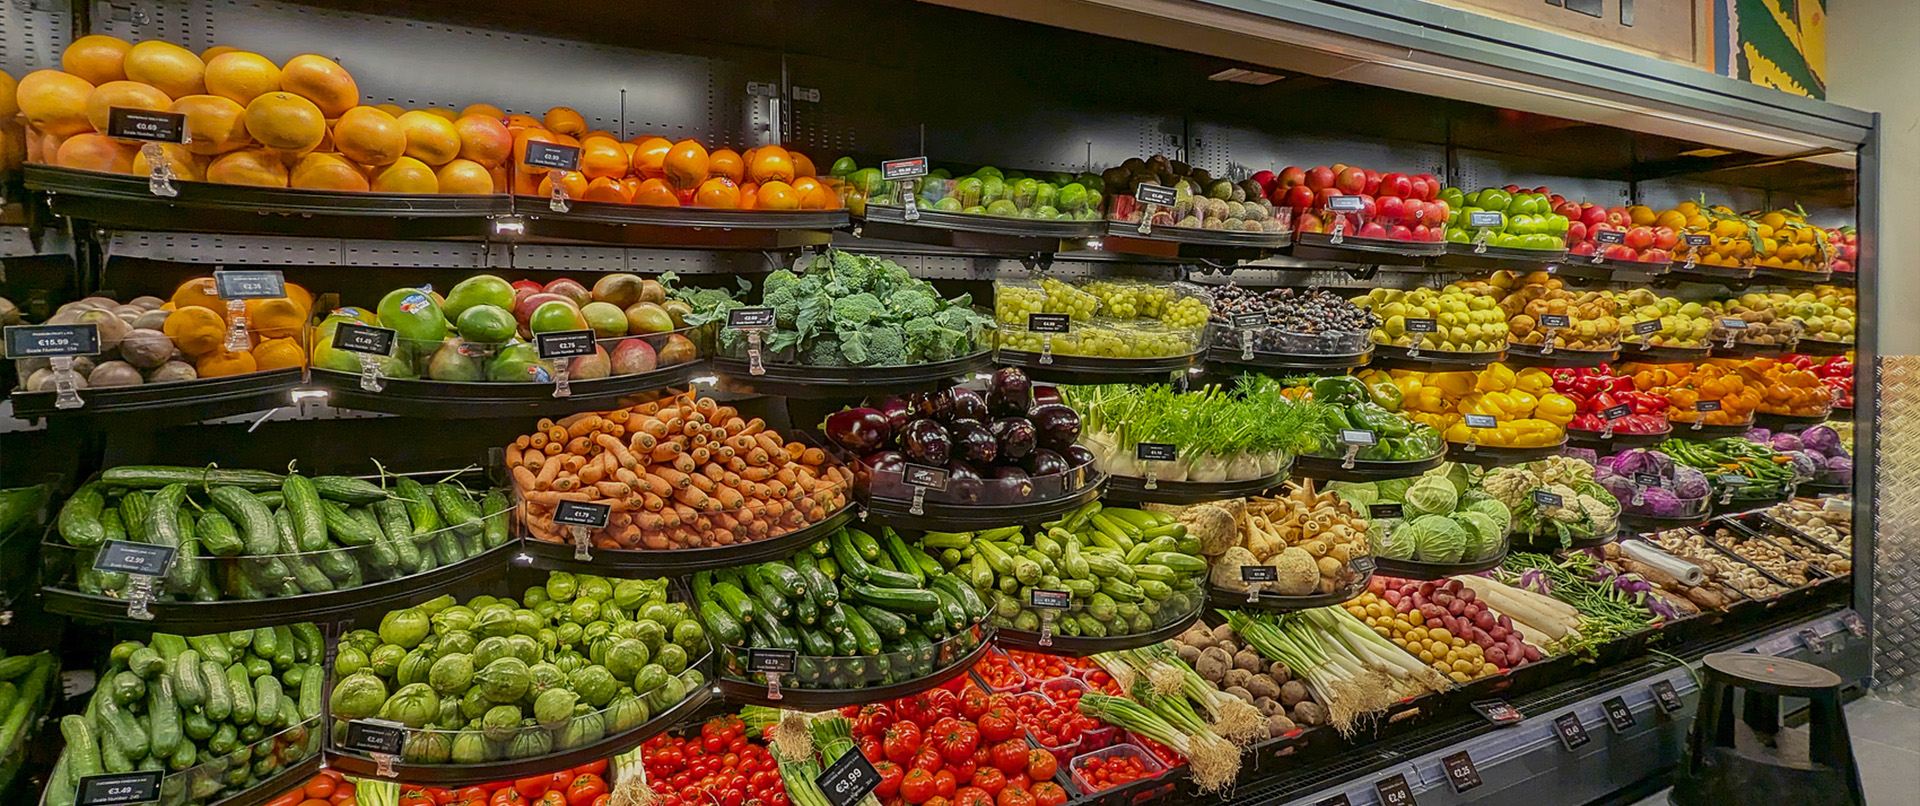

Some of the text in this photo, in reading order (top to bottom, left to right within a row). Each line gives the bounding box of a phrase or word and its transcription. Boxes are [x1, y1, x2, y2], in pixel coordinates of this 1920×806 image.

[136, 122, 158, 131] €0.69
[37, 338, 69, 346] €15.99
[835, 768, 862, 793] €3,99
[108, 786, 132, 795] €3.49
